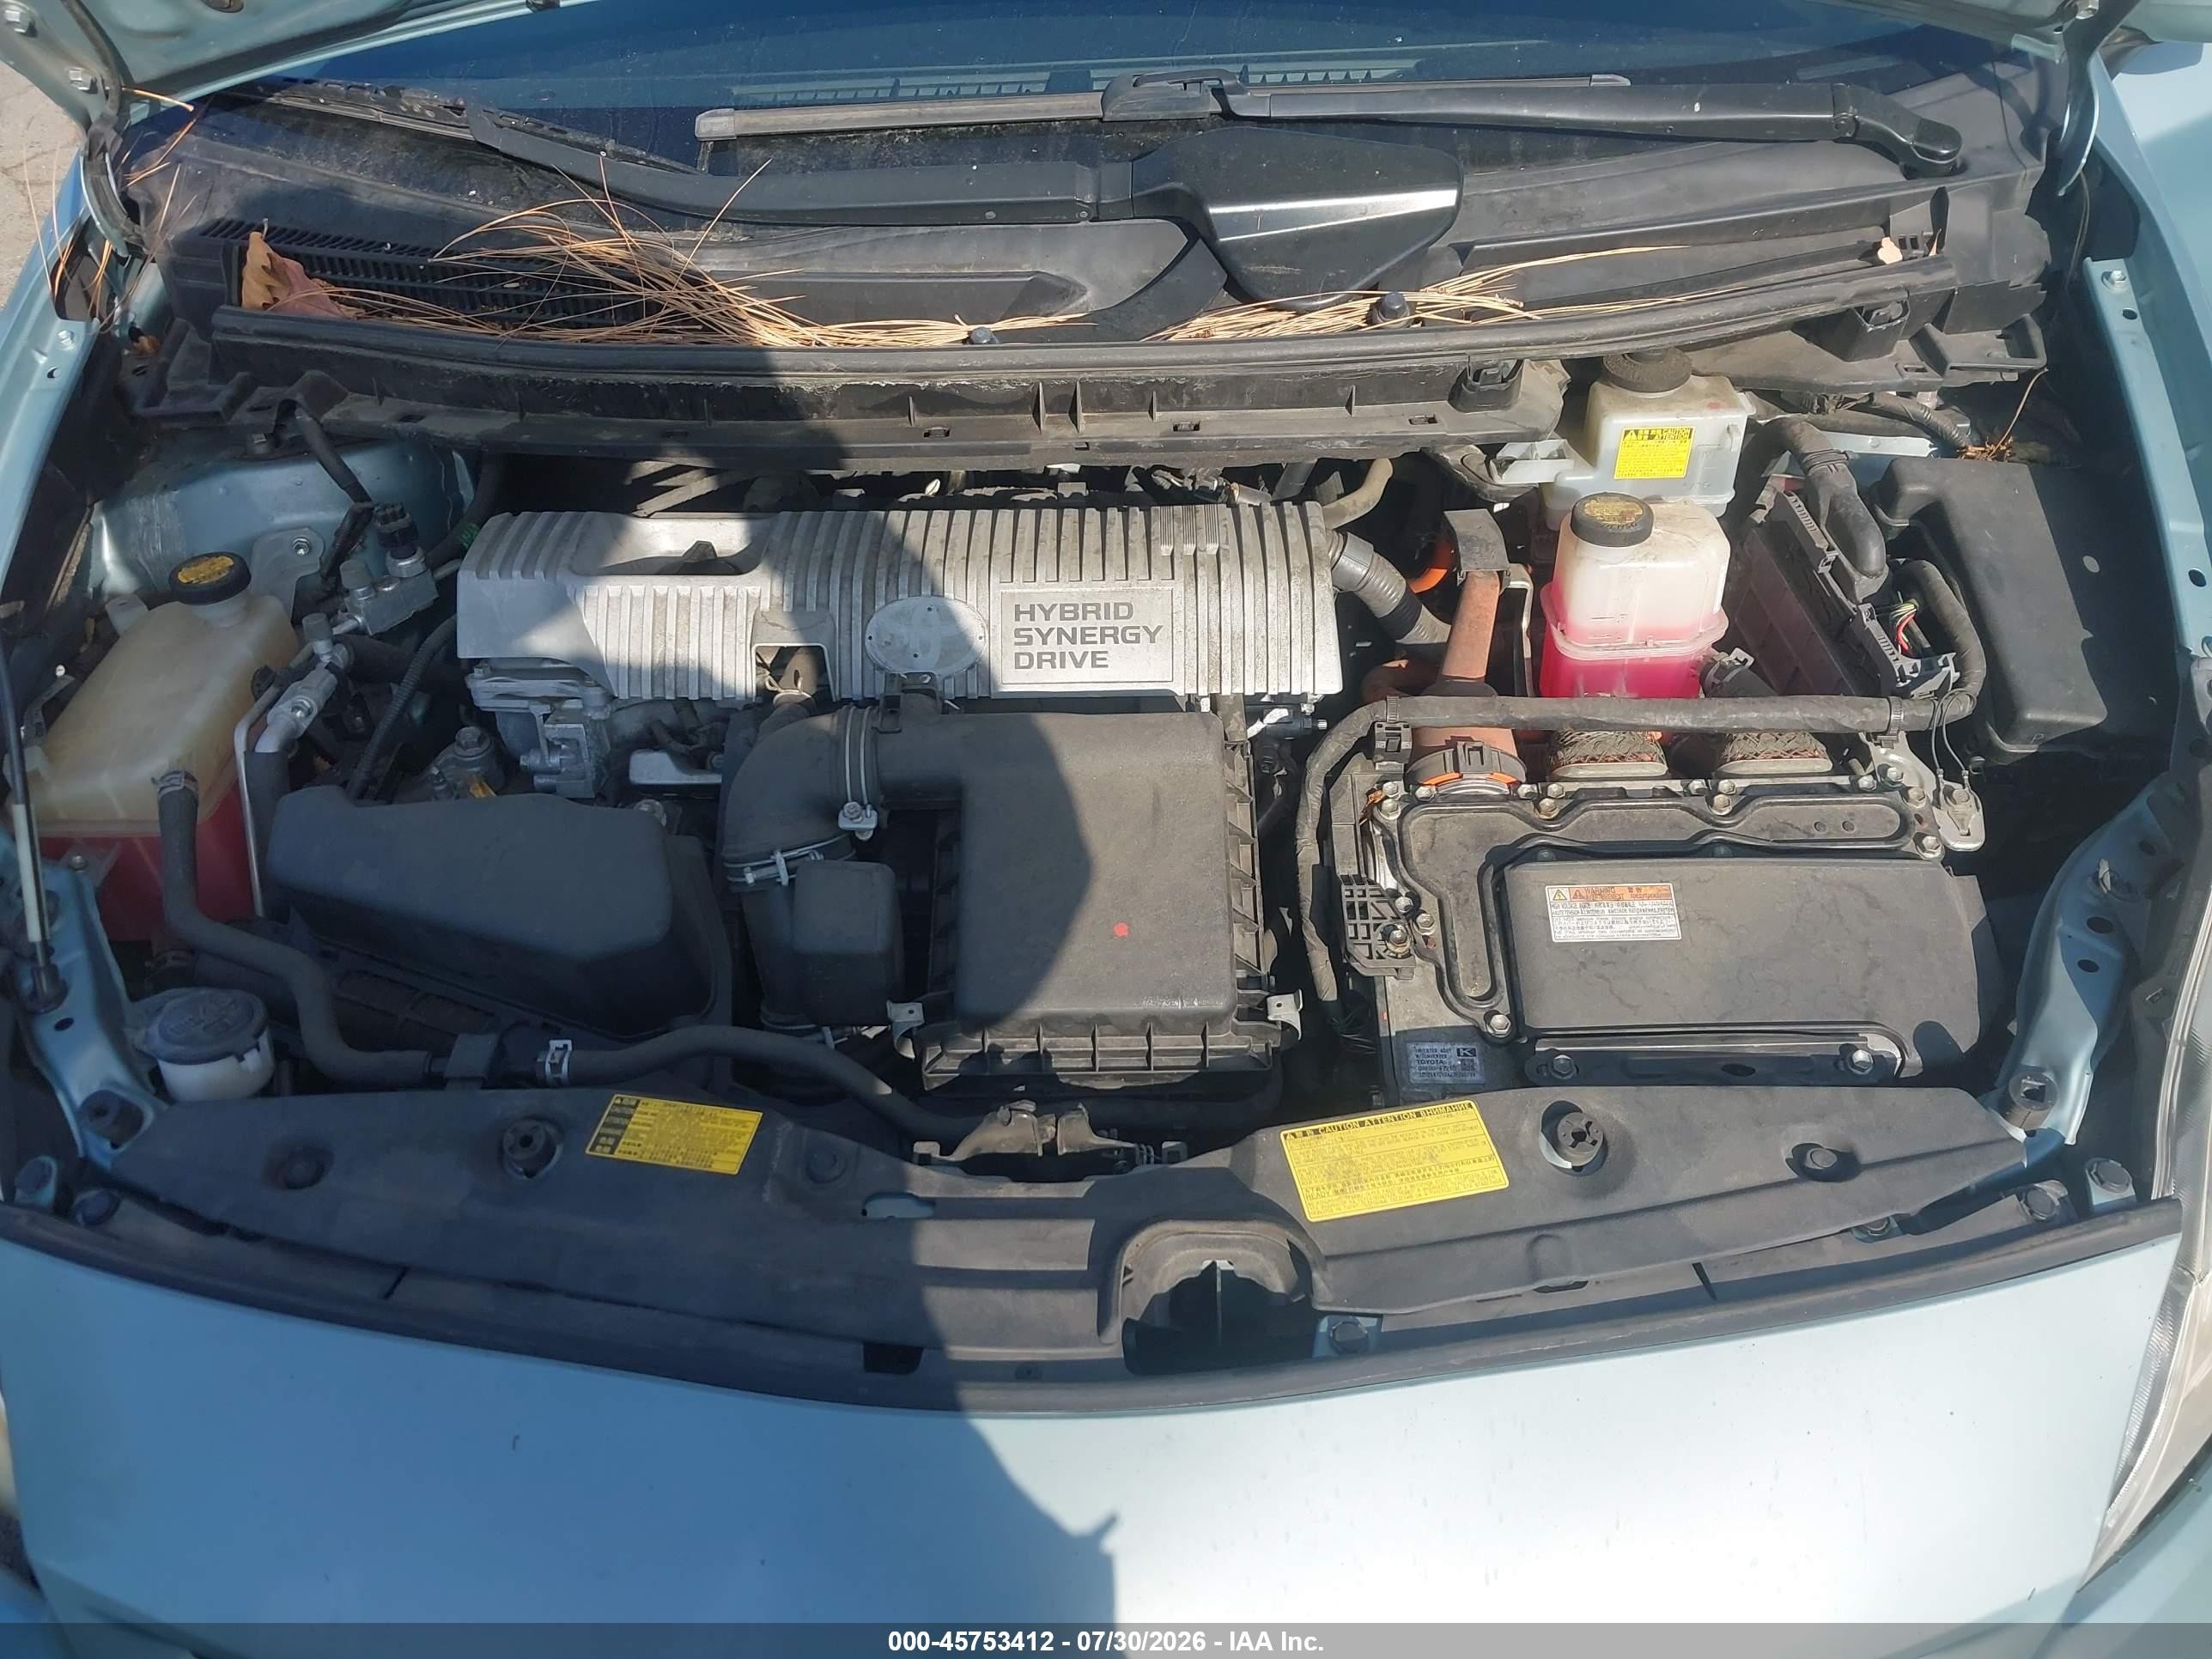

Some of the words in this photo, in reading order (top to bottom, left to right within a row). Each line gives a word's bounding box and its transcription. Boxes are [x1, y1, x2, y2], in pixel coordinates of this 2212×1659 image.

[1014, 602, 1134, 622] HYBRID
[1013, 625, 1164, 647] SYNERGY
[1014, 650, 1109, 670] DRIVE
[1585, 886, 1616, 895] WARNING
[1420, 1103, 1472, 1118] ВНИМАНИЕ
[1319, 1121, 1360, 1133] CAUTION
[1364, 1112, 1418, 1127] ATTENTION
